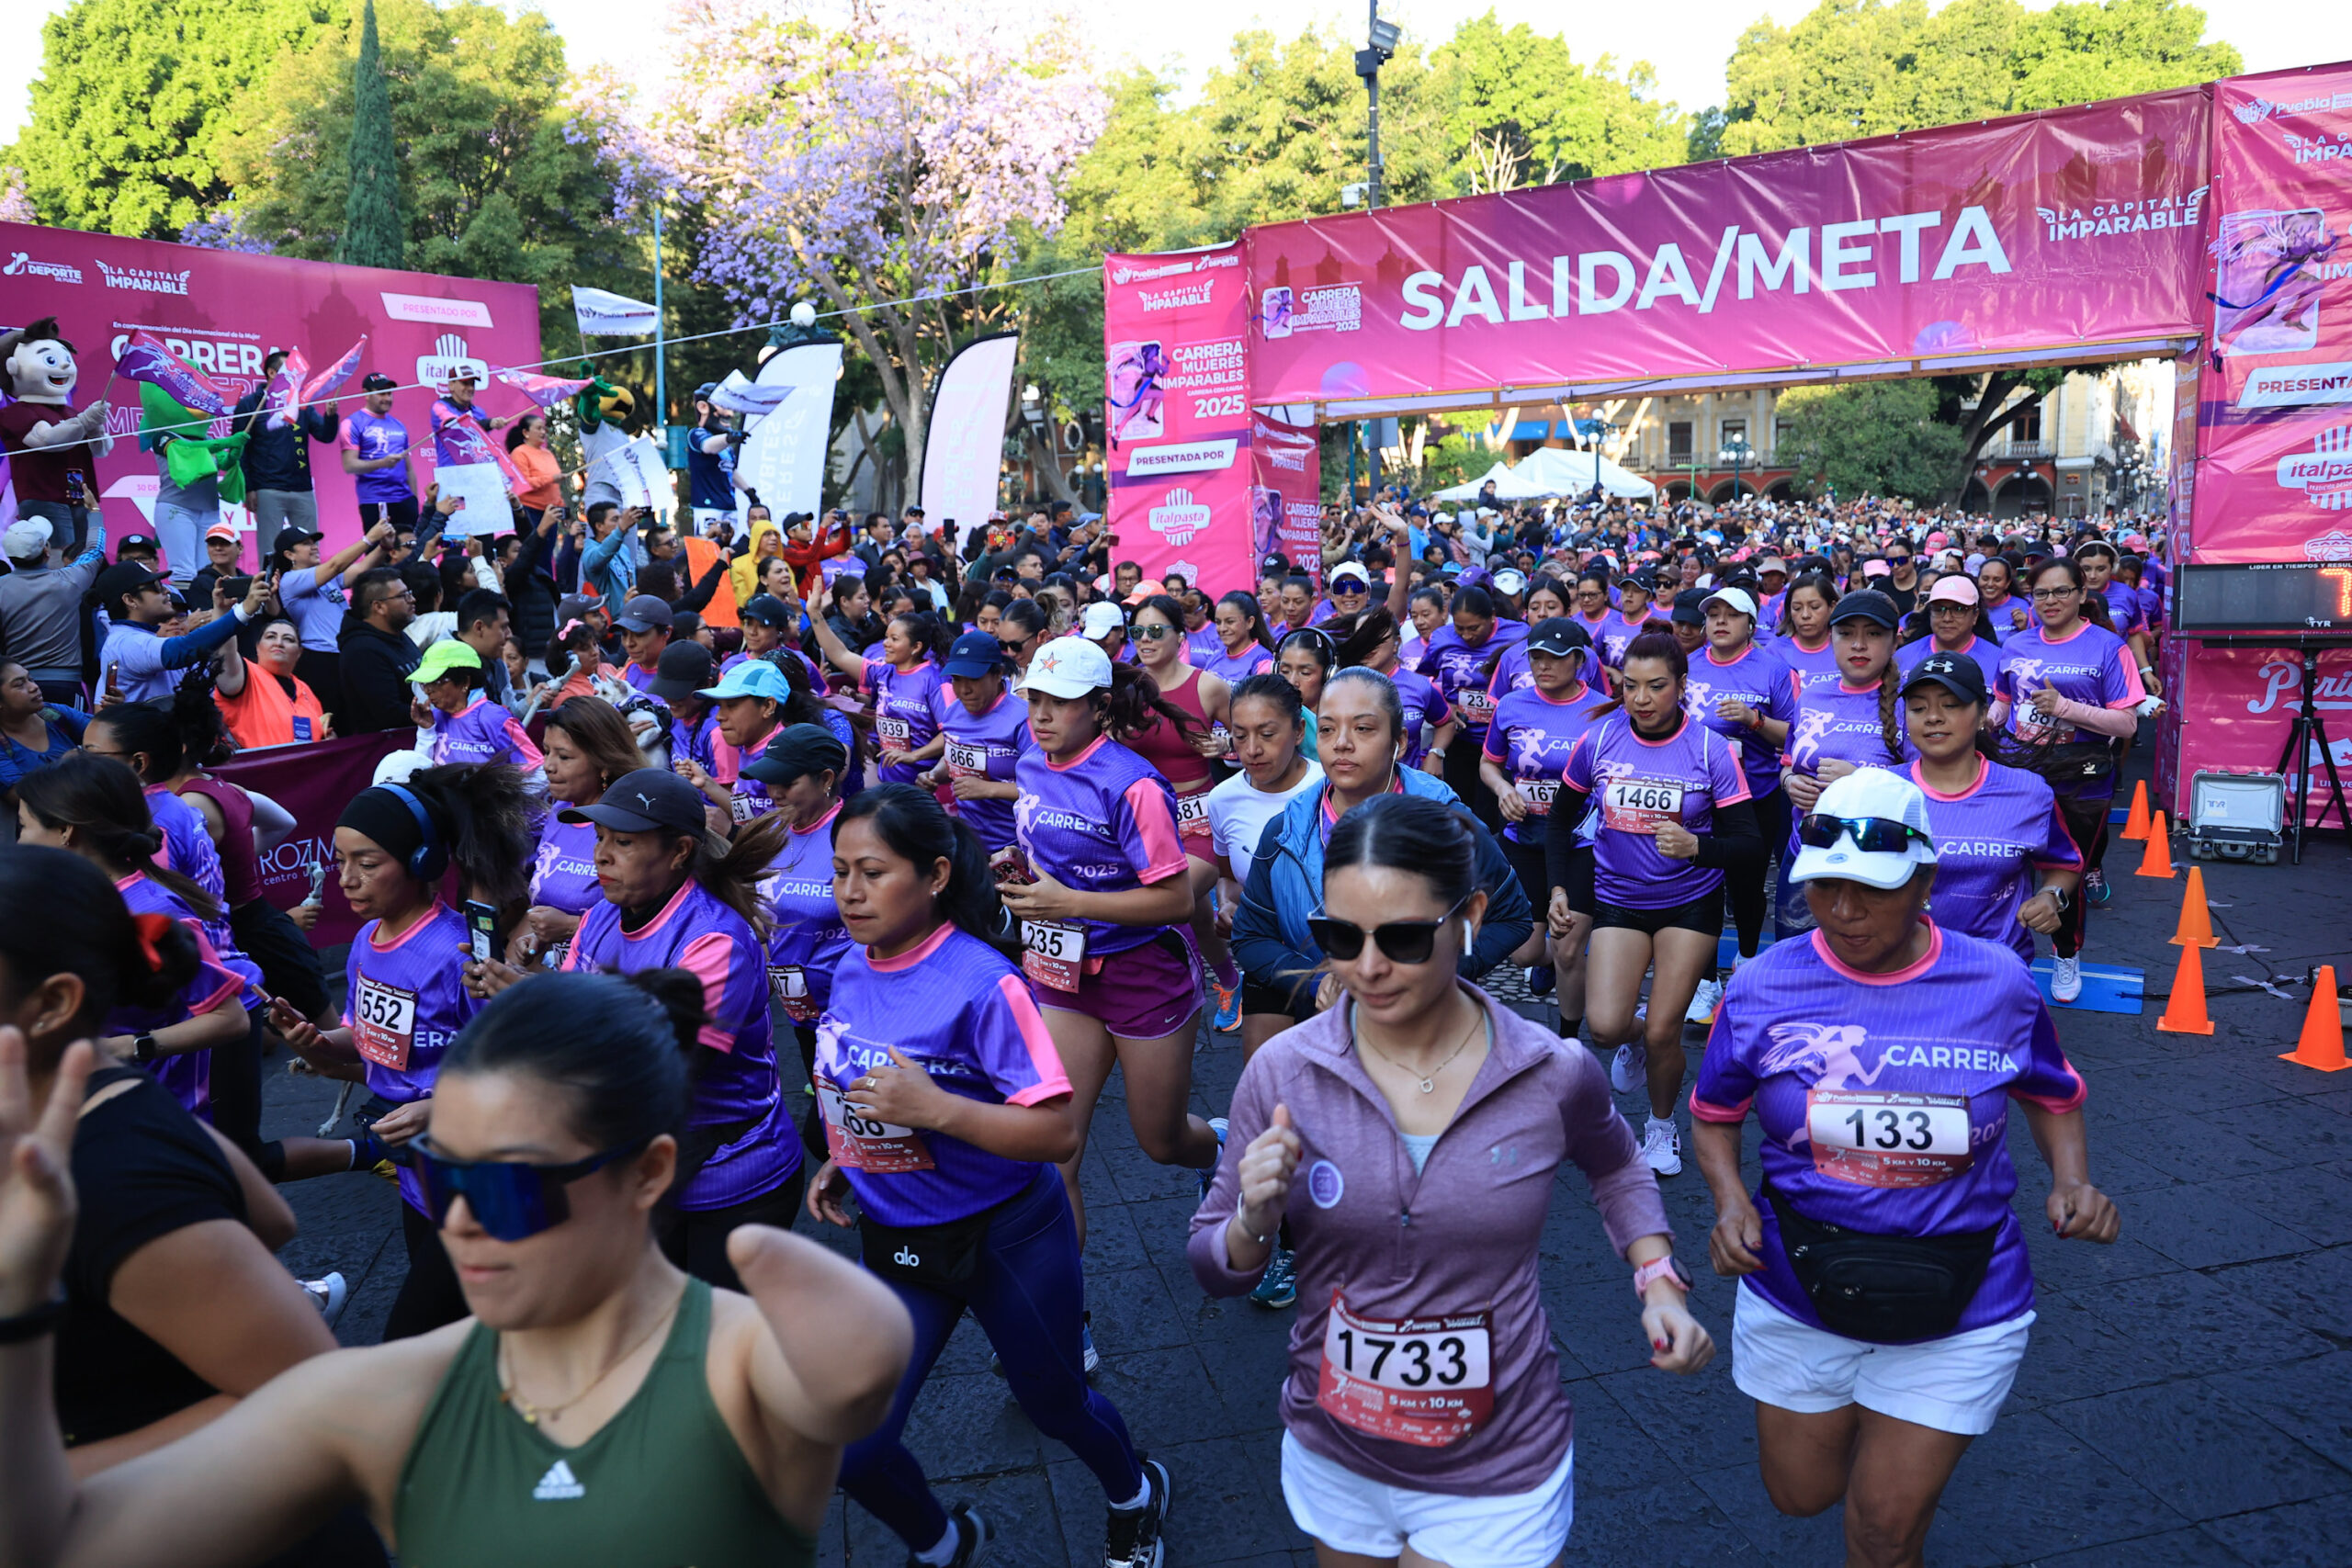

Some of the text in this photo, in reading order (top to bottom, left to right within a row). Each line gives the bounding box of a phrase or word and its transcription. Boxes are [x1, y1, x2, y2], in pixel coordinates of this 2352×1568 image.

[2276, 96, 2331, 114] Puebla
[2305, 135, 2327, 147] LA
[2059, 196, 2186, 221] LA CAPITAL
[2049, 207, 2199, 242] IMPARABLE
[28, 265, 82, 279] DEPORTE
[109, 266, 181, 281] LA CAPITAL
[1398, 205, 2012, 331] SALIDA/META
[106, 276, 188, 295] IMPARABLE
[1163, 285, 1204, 298] CAPITAL
[1143, 291, 1211, 312] IMPARABLE
[1301, 287, 1361, 304] CARRERA
[1308, 297, 1362, 312] MUJERES
[403, 304, 477, 318] PRESENTADO POR
[1292, 308, 1362, 326] IMPARABLES
[1335, 320, 1361, 332] 2025
[1172, 341, 1244, 362] CARRERA
[1182, 355, 1244, 374] MUJERES
[1163, 369, 1245, 389] IMPARABLES
[184, 395, 216, 414] 2025
[1194, 394, 1245, 419] 2025
[1136, 450, 1225, 466] PRESENTADA POR
[1156, 512, 1204, 525] italpasta
[877, 720, 903, 737] 1939
[1836, 722, 1904, 741] CARREA
[950, 748, 975, 768] 866
[1616, 786, 1672, 810] 1466
[1943, 841, 2034, 858] CARRER
[264, 873, 298, 886] centro
[1073, 863, 1119, 878] 2025
[1028, 926, 1063, 957] 235
[357, 986, 402, 1031] 1552
[1885, 1044, 2019, 1073] CARRERA
[1846, 1109, 1933, 1150] 133
[881, 1142, 892, 1150] 10
[1883, 1157, 1891, 1166] 5
[894, 1245, 920, 1267] alo
[1338, 1328, 1467, 1386] 1733
[1389, 1394, 1397, 1405] 5
[1399, 1399, 1417, 1408] KM
[1429, 1396, 1445, 1408] 10
[1447, 1399, 1464, 1408] KM
